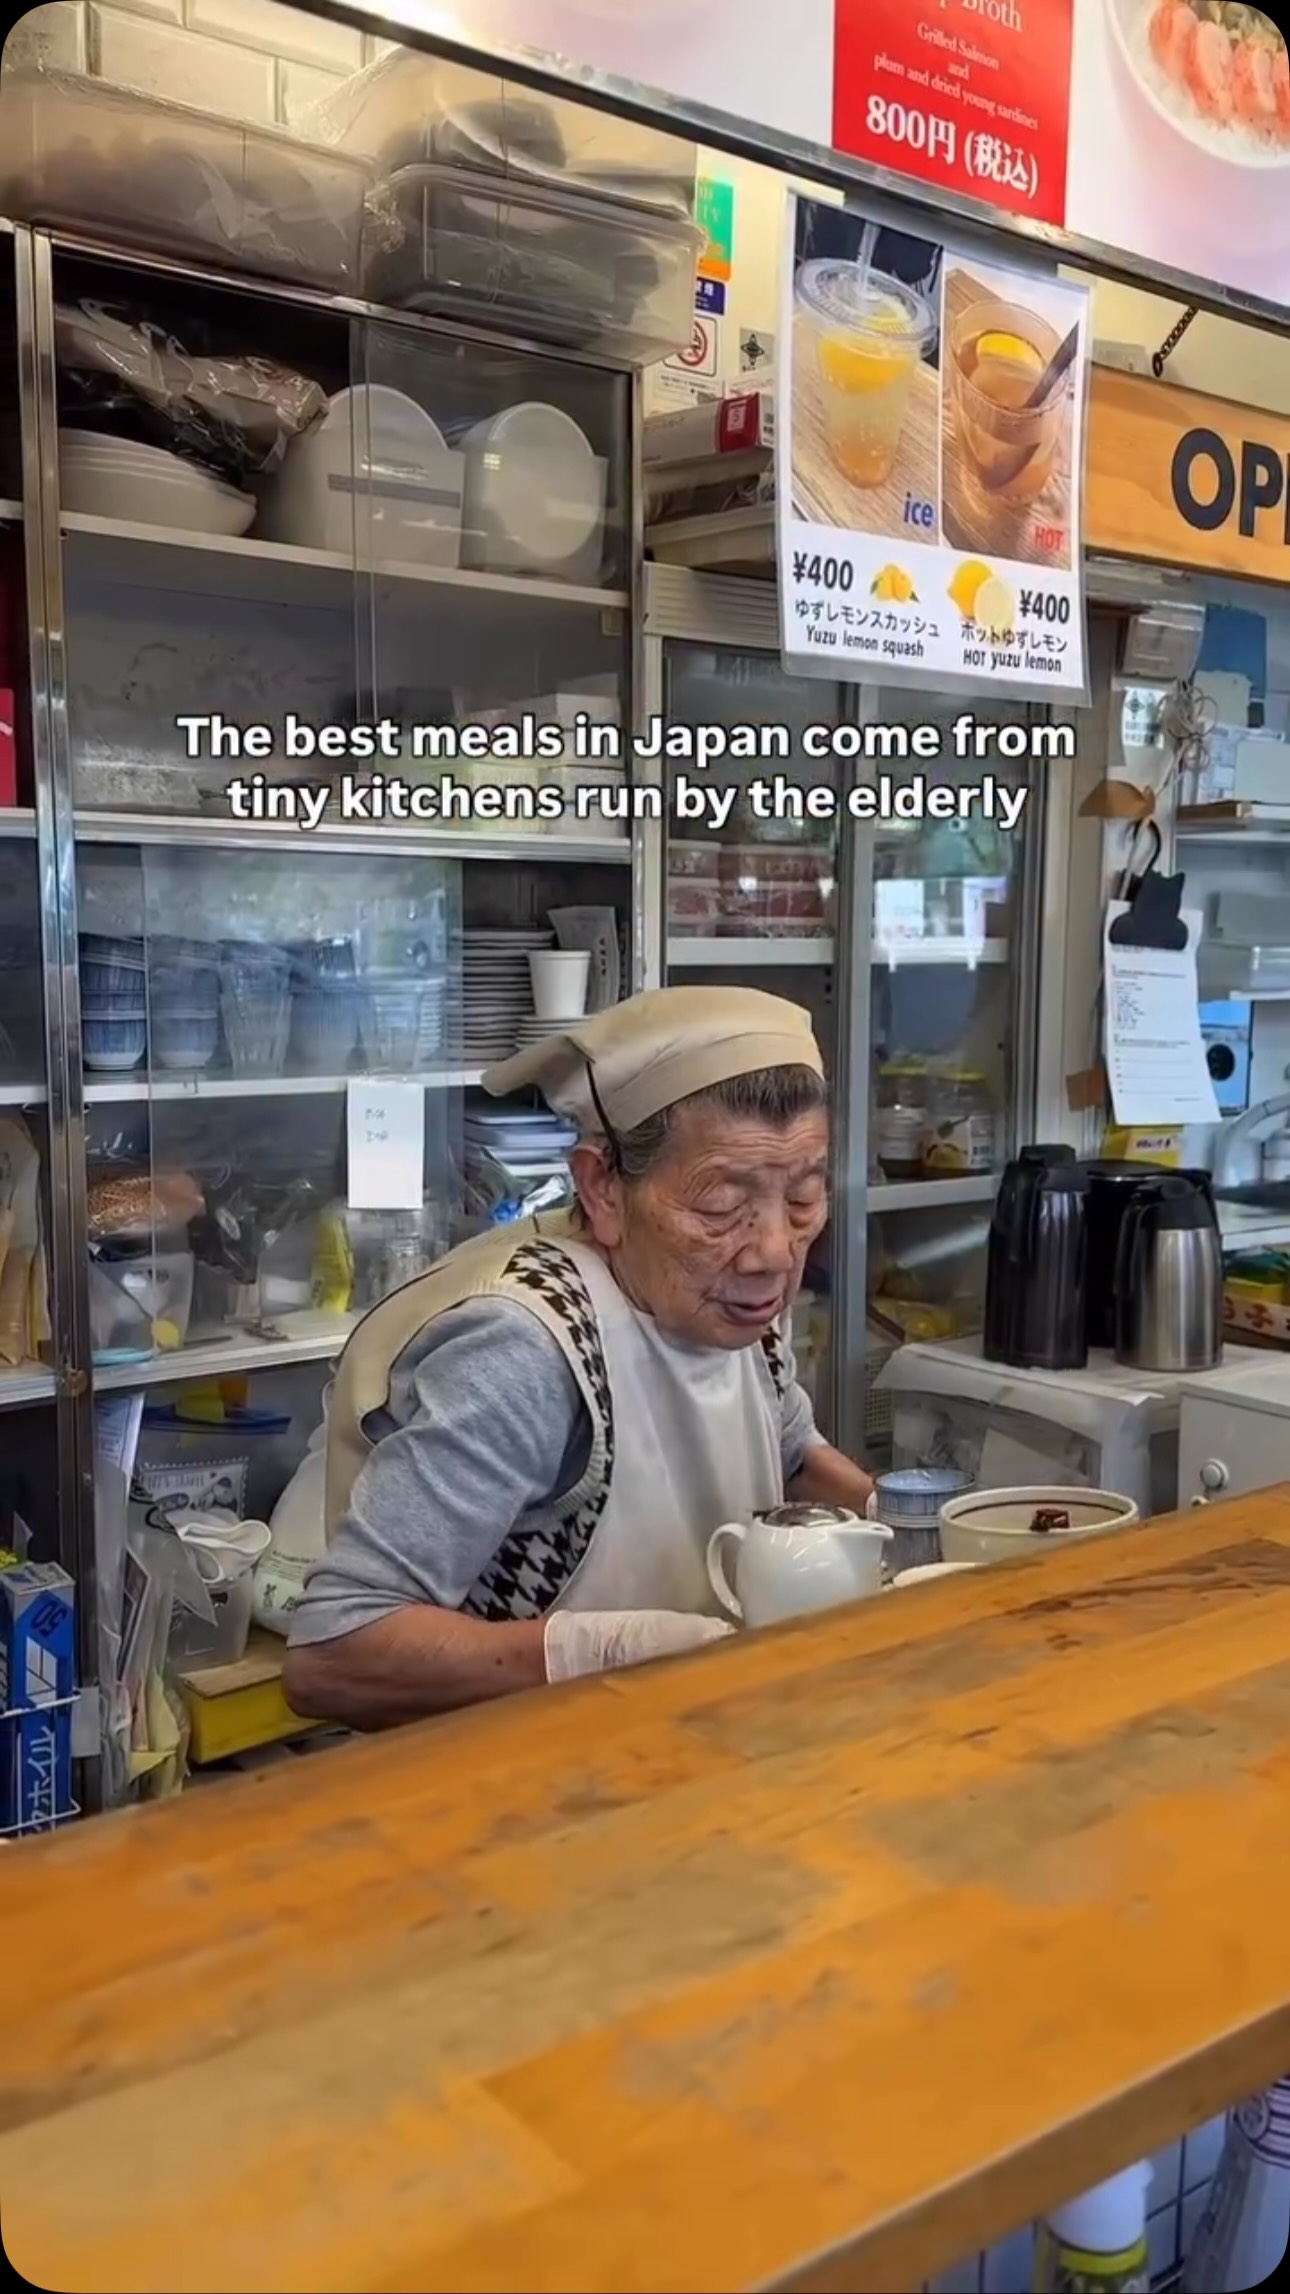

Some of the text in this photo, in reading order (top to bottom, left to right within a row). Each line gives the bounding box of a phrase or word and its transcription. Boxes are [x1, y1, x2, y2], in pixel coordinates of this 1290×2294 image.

[917, 21, 999, 70] Grilled Salmon
[948, 62, 970, 80] and
[874, 53, 1039, 129] plum and dried young sardines
[866, 95, 1039, 199] 800円 (税込)
[1171, 428, 1290, 546] OP
[903, 492, 934, 526] ice
[1034, 526, 1064, 551] HOT
[792, 551, 854, 592] ¥400
[795, 597, 940, 637] ゆずレモンスカッシュ
[1019, 589, 1070, 624] ¥400
[806, 624, 924, 659] Yuzu lemon squash
[961, 621, 1068, 653] ホットゆずレモン
[963, 648, 1062, 672] HOT yuzu lemon
